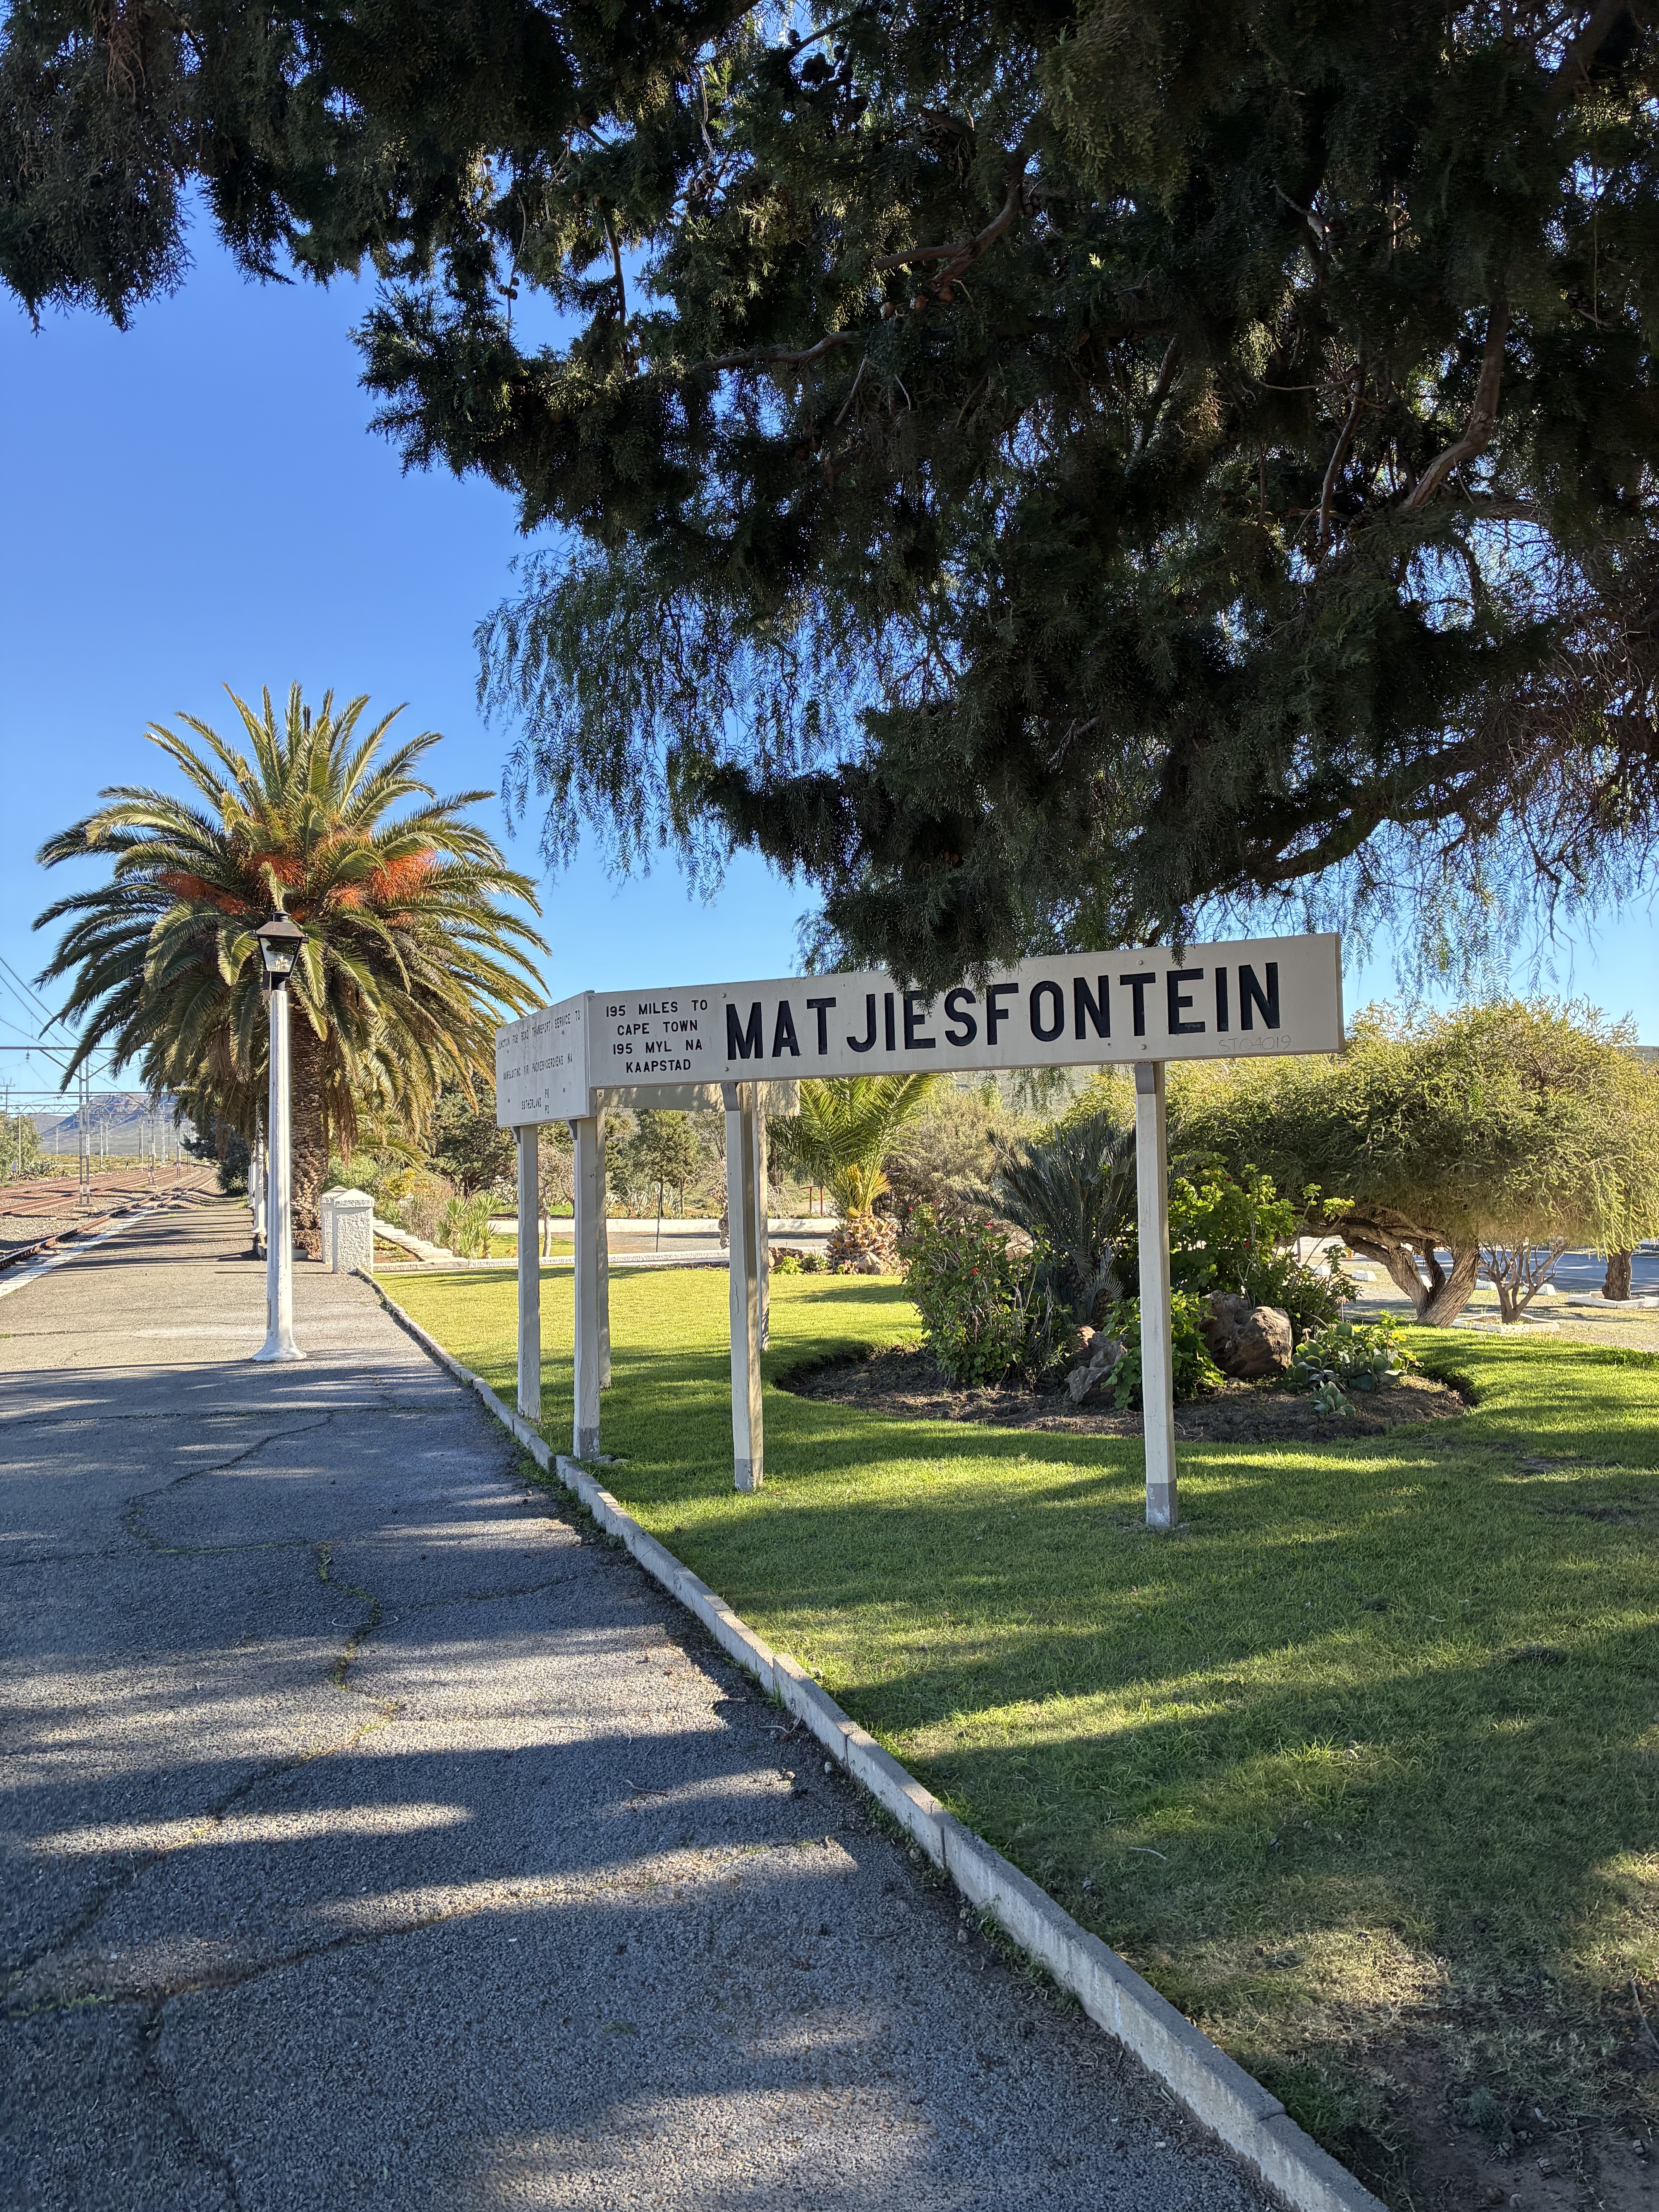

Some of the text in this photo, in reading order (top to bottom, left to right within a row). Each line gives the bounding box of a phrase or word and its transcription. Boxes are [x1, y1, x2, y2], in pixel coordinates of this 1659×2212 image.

[606, 1000, 708, 1017] 195 MILES TO
[726, 962, 1280, 1060] MATJIESFONTEIN
[555, 1013, 570, 1029] SERVICE
[575, 1010, 580, 1021] TO
[617, 1020, 697, 1036] CAPE TOWN
[613, 1039, 702, 1055] 195 MYL NA
[567, 1053, 572, 1063] NA
[626, 1059, 691, 1073] KAAPSTAD
[522, 1097, 541, 1109] SUTHERLAND
